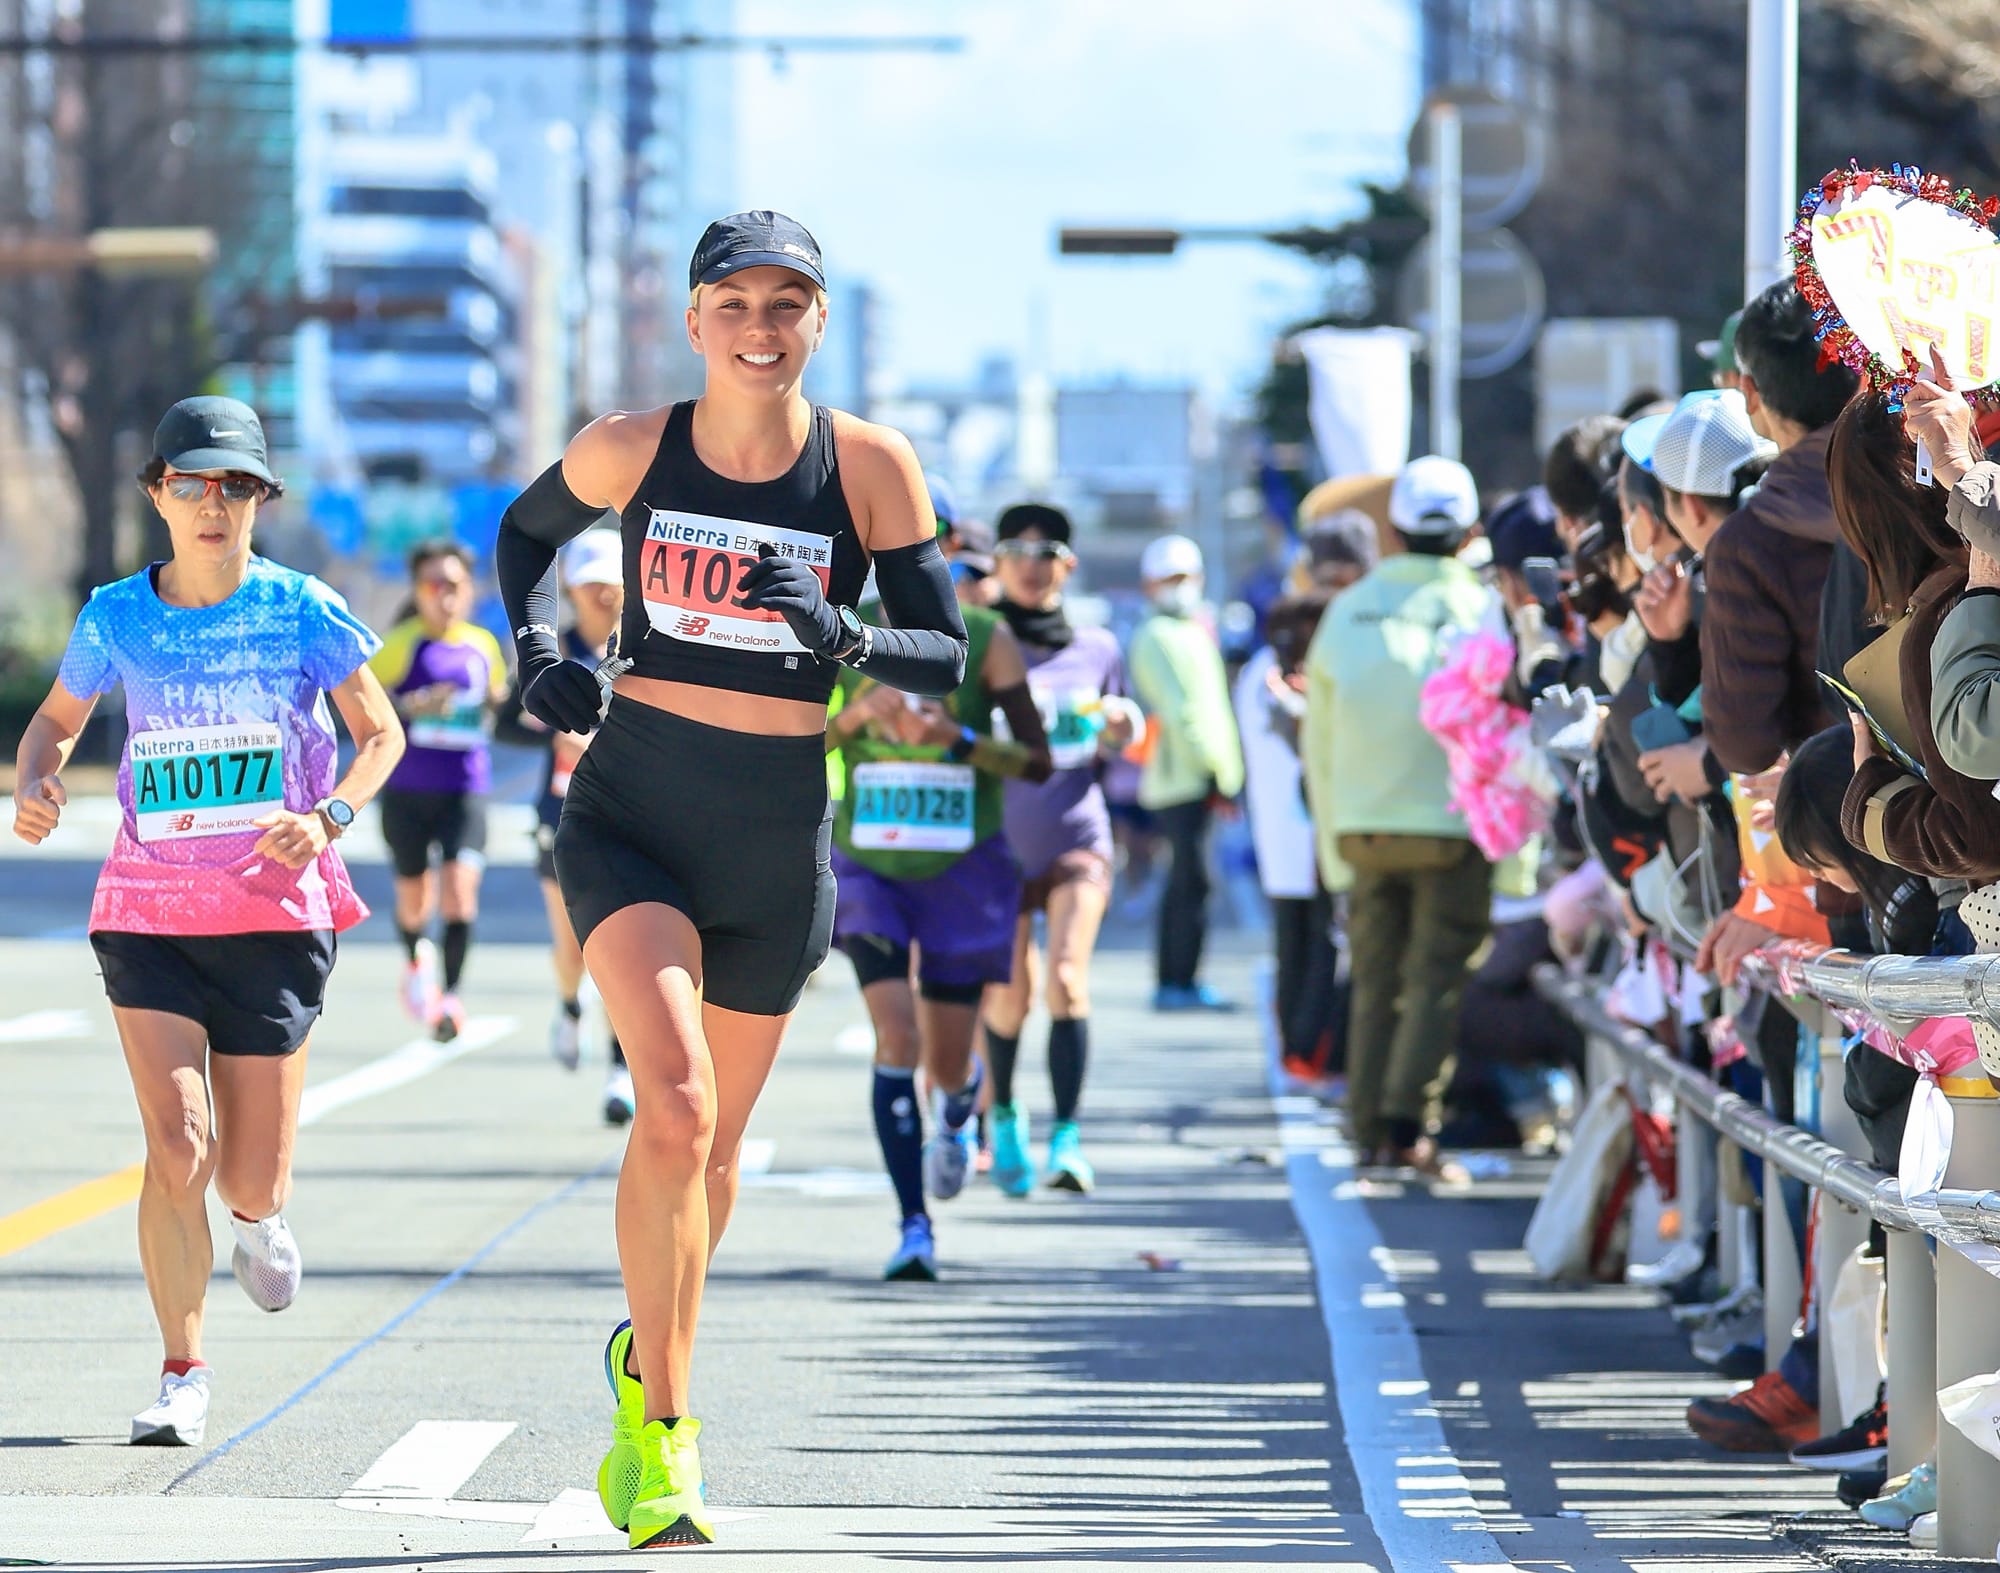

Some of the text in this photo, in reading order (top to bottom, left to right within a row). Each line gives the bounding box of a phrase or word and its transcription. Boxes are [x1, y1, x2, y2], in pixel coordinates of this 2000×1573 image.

[652, 521, 729, 547] Niterra
[709, 631, 732, 642] new
[734, 634, 781, 647] balance
[134, 738, 194, 757] Niterra
[140, 750, 274, 805] A10177
[196, 820, 215, 830] new
[217, 817, 255, 829] balance
